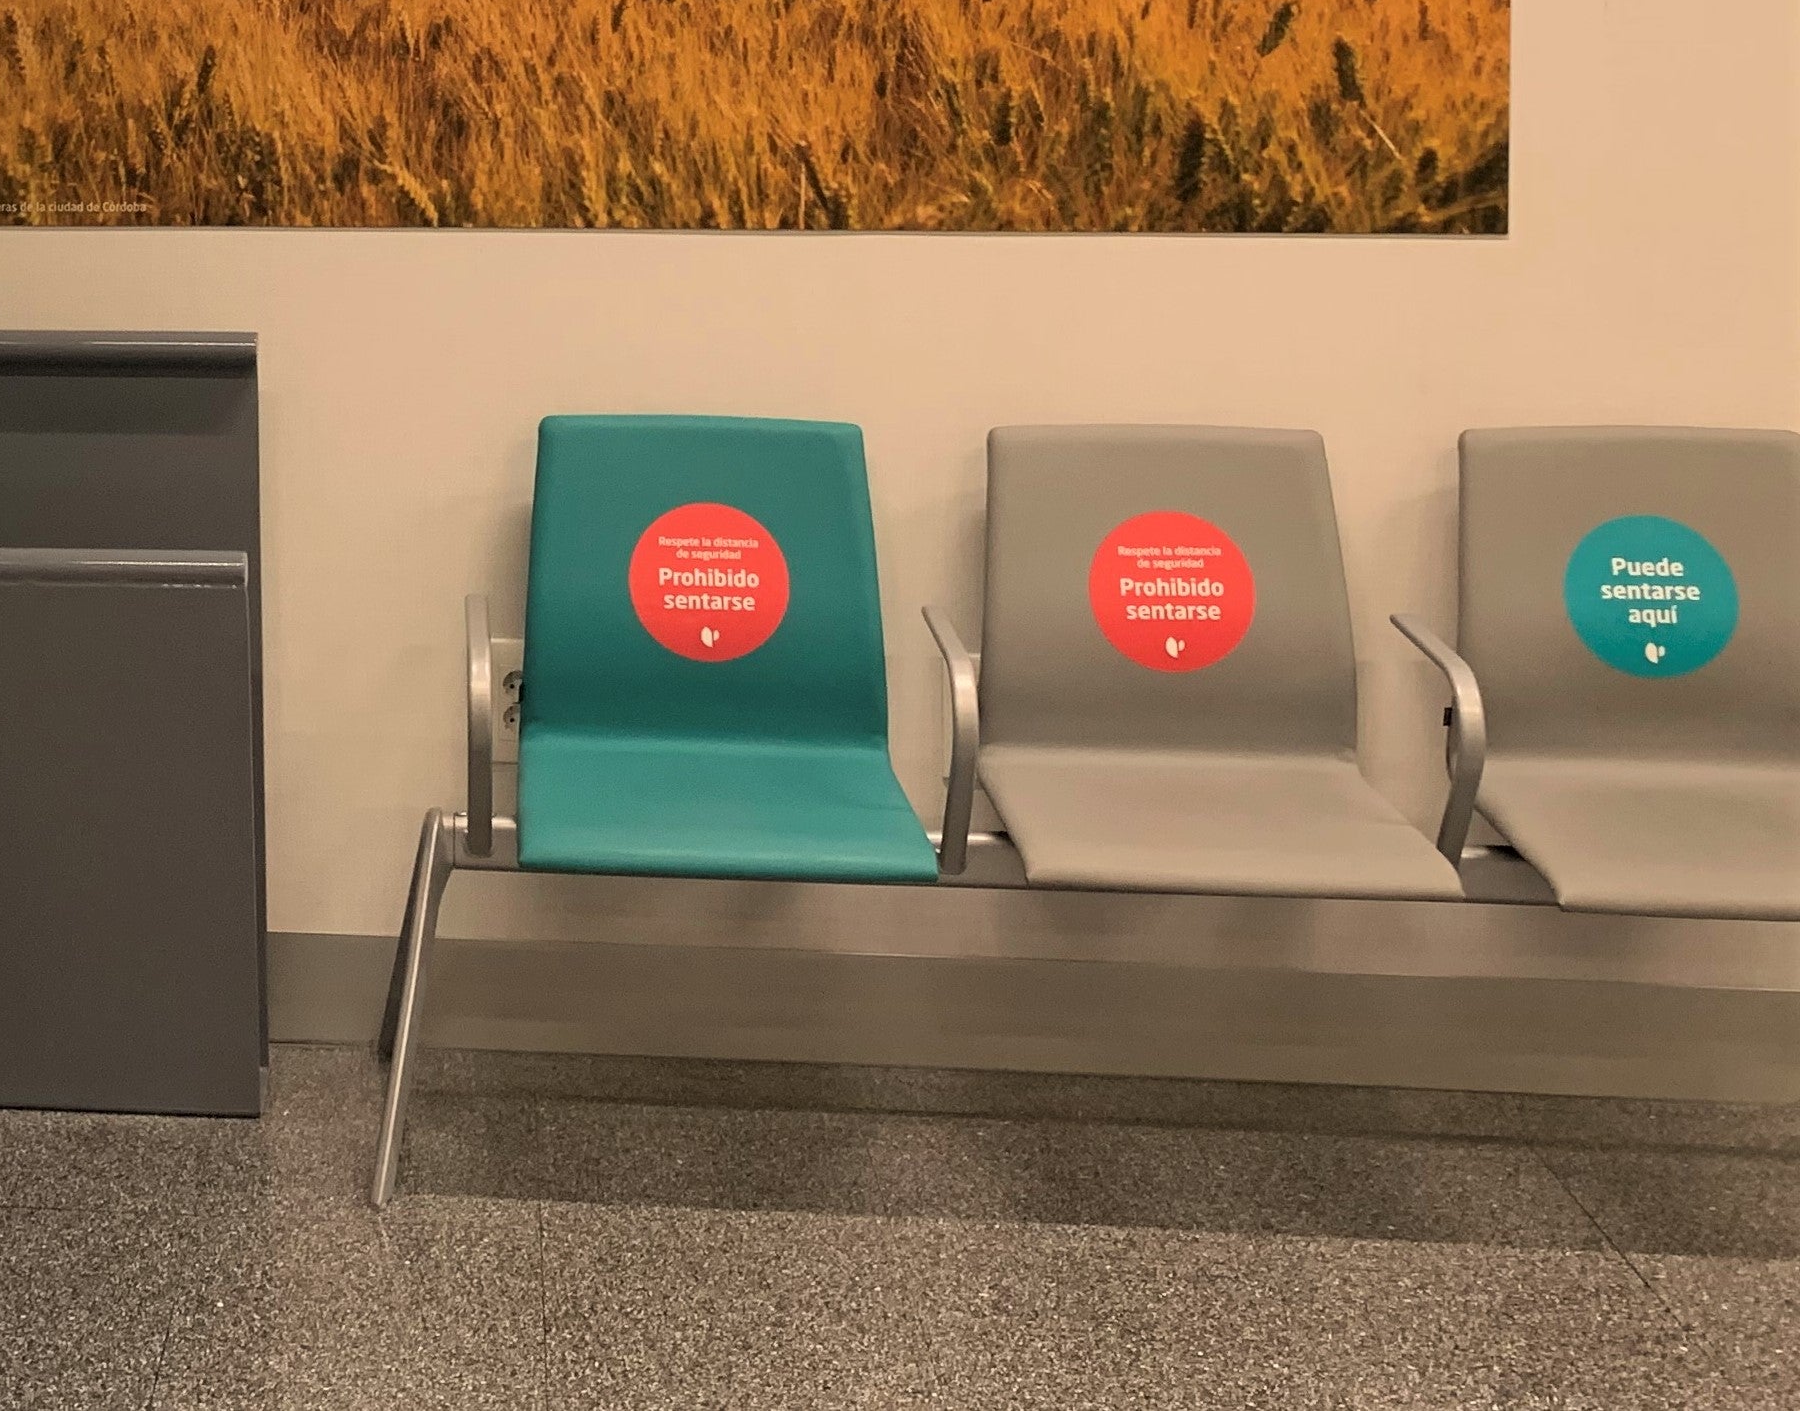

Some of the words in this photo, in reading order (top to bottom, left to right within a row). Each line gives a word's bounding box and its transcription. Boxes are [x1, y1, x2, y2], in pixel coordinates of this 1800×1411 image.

[20, 201, 33, 213] de
[36, 201, 46, 213] la
[49, 201, 84, 213] ciudad
[86, 201, 100, 213] de
[658, 536, 700, 549] Respete
[701, 536, 712, 547] la
[713, 537, 759, 549] distancia
[676, 548, 690, 559] de
[691, 549, 742, 562] seguridad
[1117, 546, 1161, 558] Respete
[1162, 546, 1173, 556] la
[1174, 546, 1222, 557] distancia
[1137, 558, 1150, 569] de
[1152, 558, 1205, 571] seguridad
[1611, 557, 1684, 577] Puede
[658, 567, 760, 588] Prohibido
[1119, 577, 1224, 597] Prohibido
[1601, 583, 1701, 601] sentarse
[663, 593, 756, 611] sentarse
[1126, 602, 1221, 621] sentarse
[1628, 605, 1678, 628] aquí
